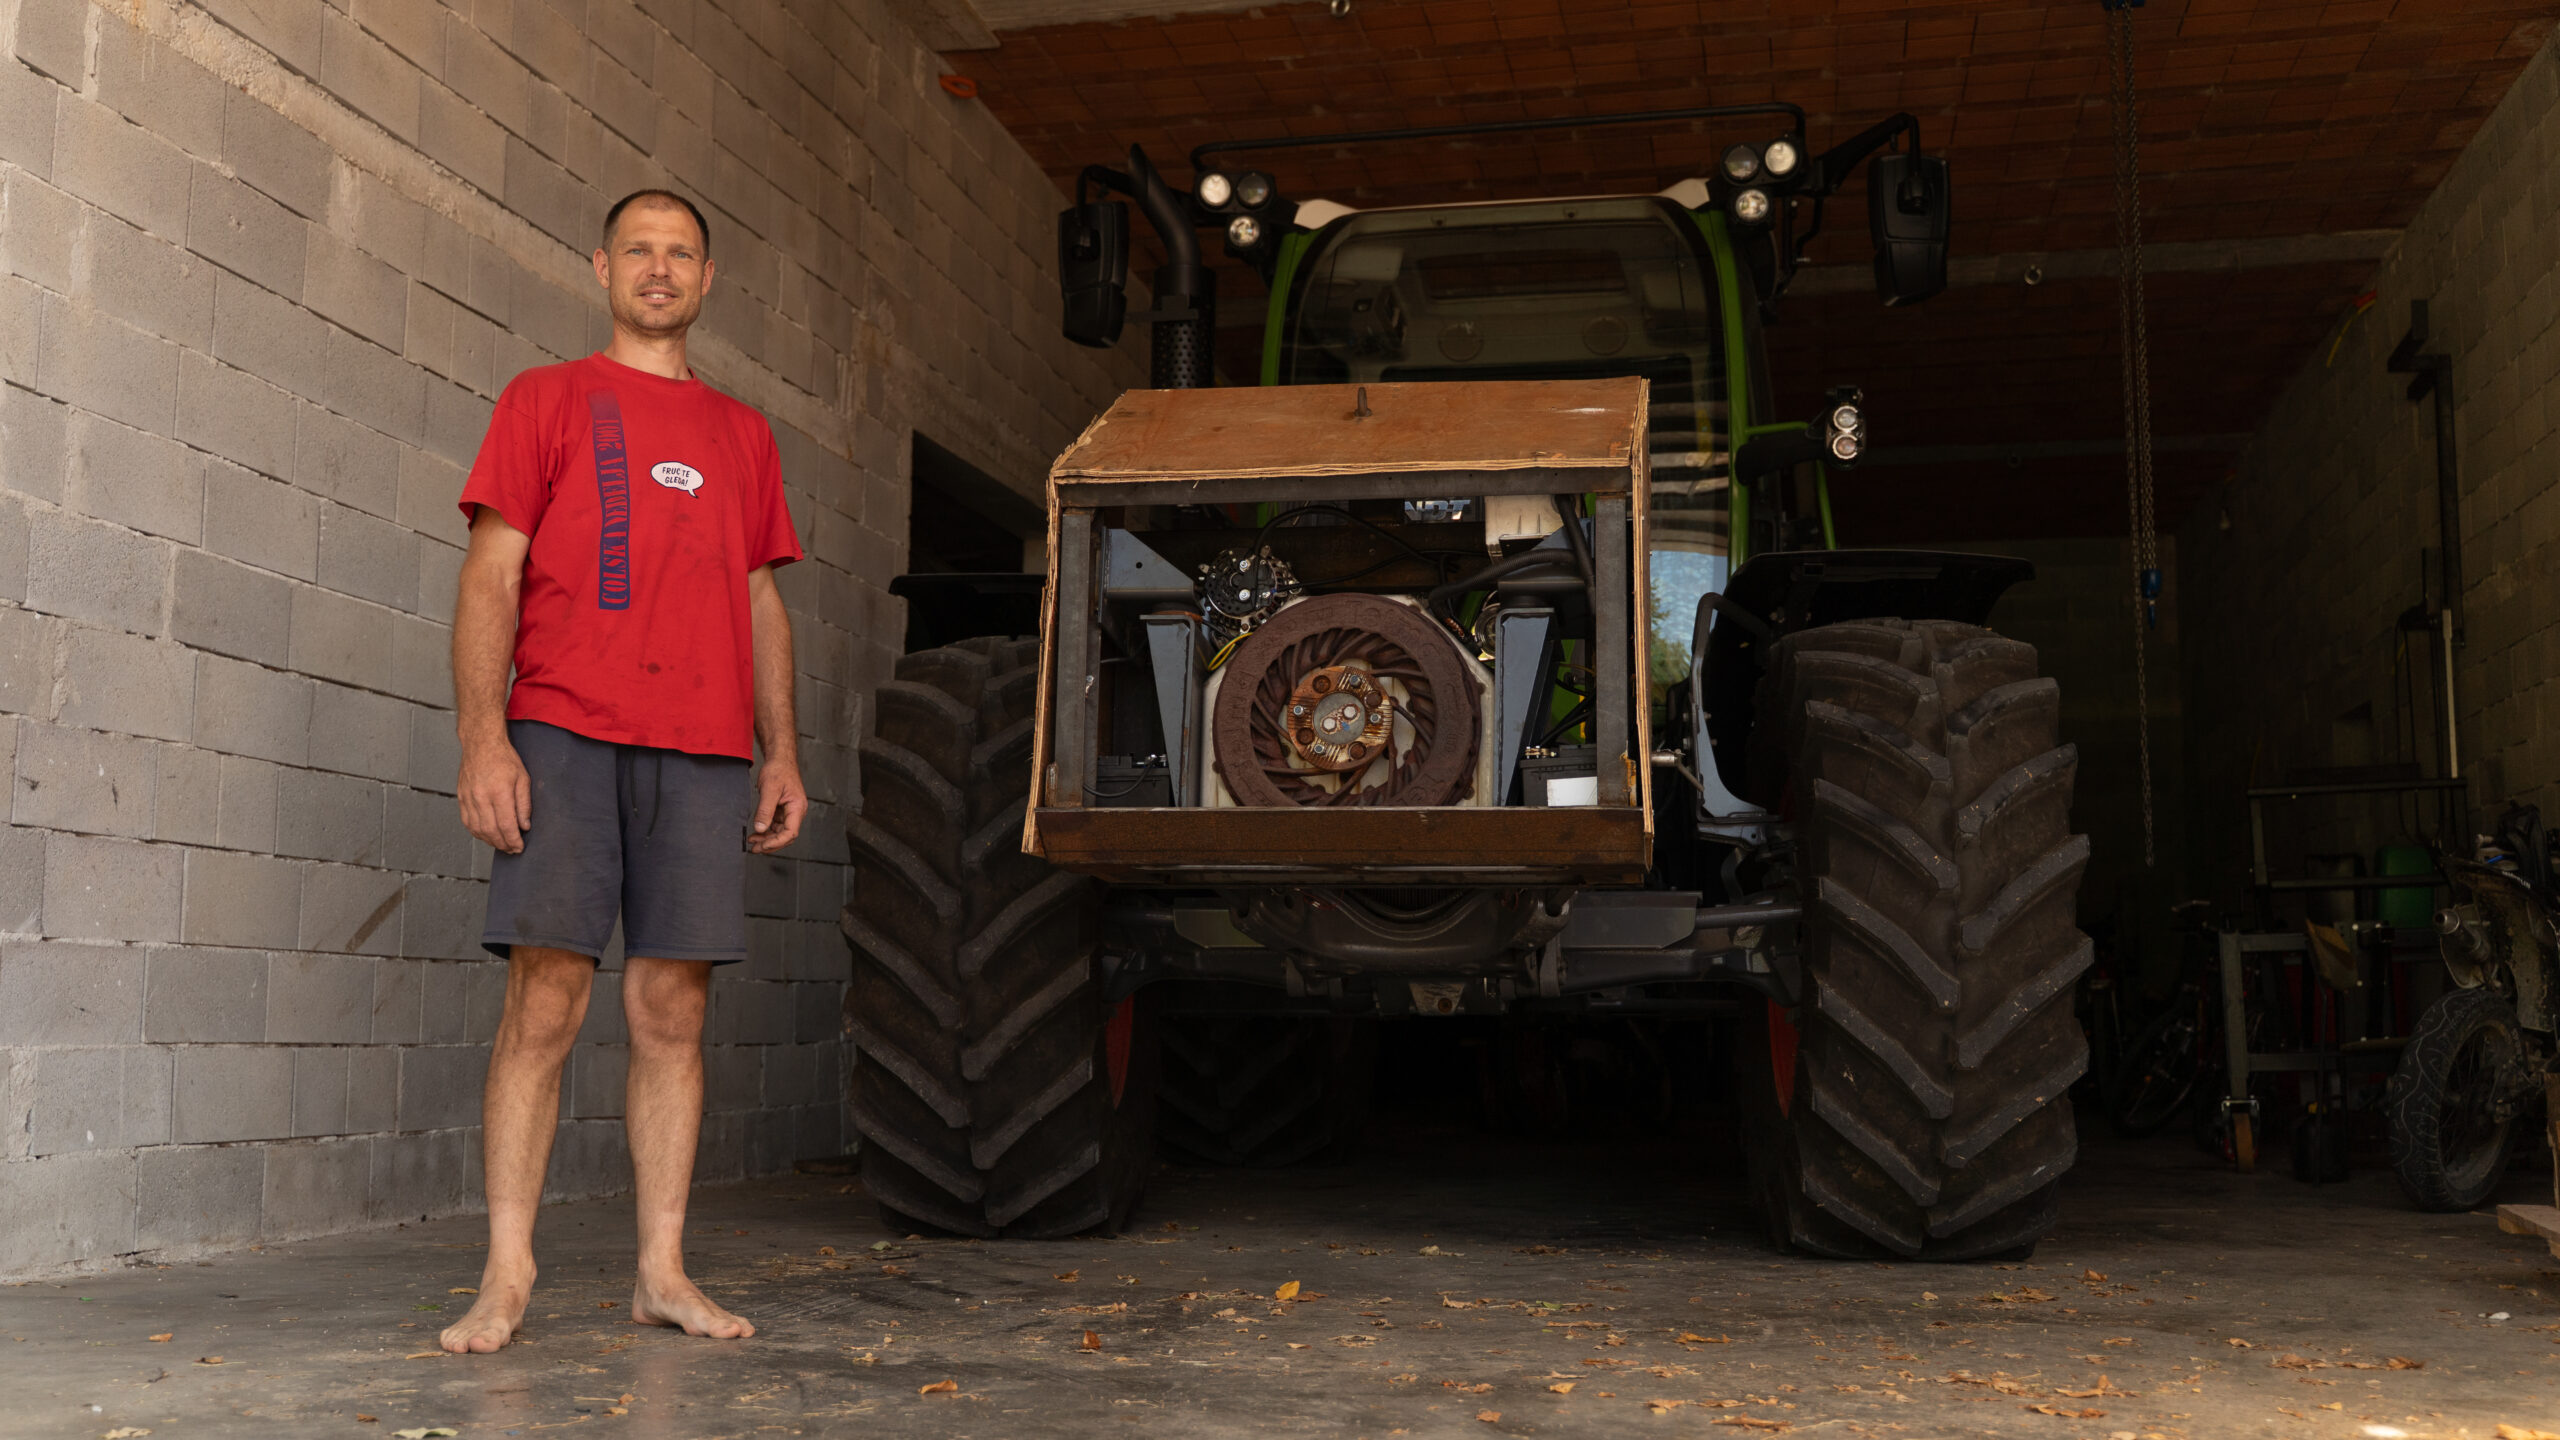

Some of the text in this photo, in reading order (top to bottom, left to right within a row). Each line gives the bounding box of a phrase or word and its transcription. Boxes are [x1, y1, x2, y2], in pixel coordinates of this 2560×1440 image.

[595, 419, 622, 451] 2001
[662, 466, 691, 478] FRUC TE
[600, 457, 627, 529] NEDELJA
[1404, 499, 1472, 521] NDT
